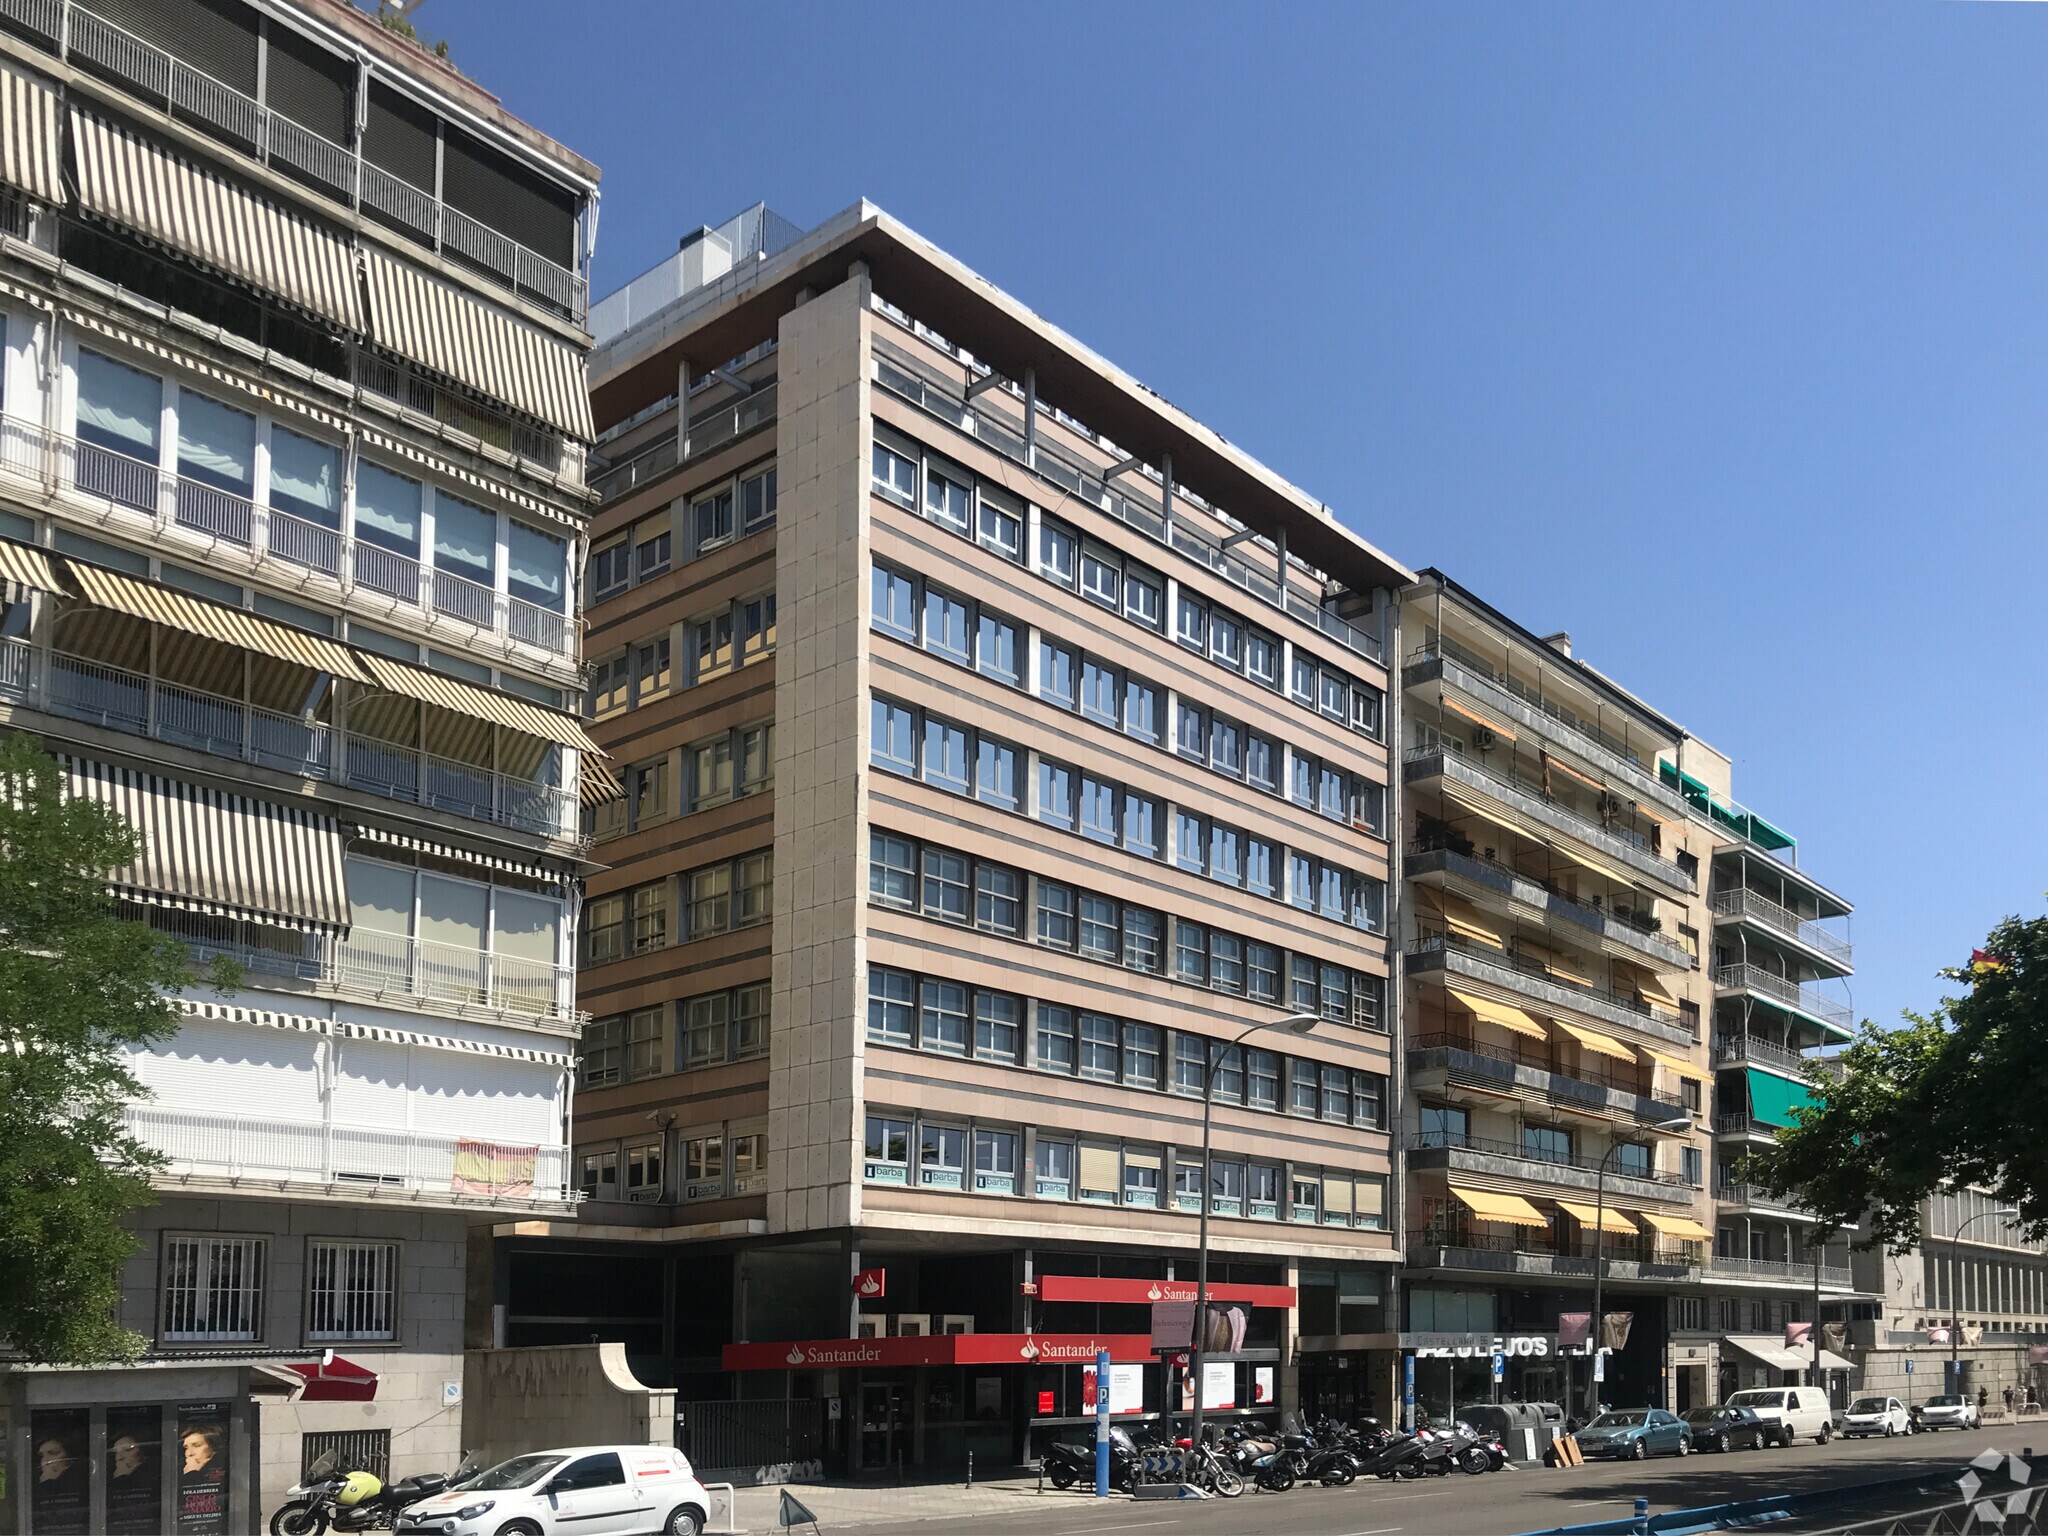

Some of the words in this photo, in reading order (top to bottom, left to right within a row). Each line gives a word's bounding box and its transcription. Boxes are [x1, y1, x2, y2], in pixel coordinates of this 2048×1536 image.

[876, 1166, 903, 1177] barba
[748, 1177, 768, 1187] barb
[933, 1172, 958, 1182] barba
[986, 1177, 1010, 1187] barba
[1044, 1183, 1066, 1193] barba
[1134, 1192, 1154, 1201] barba
[1181, 1196, 1200, 1206] barba
[1220, 1200, 1238, 1209] barba
[1257, 1205, 1274, 1214] barba
[1297, 1209, 1313, 1218] barba
[1163, 1286, 1214, 1301] Santaner
[808, 1344, 881, 1363] Santander
[1042, 1340, 1108, 1358] Santander
[1495, 1355, 1502, 1373] P
[1099, 1388, 1108, 1403] P
